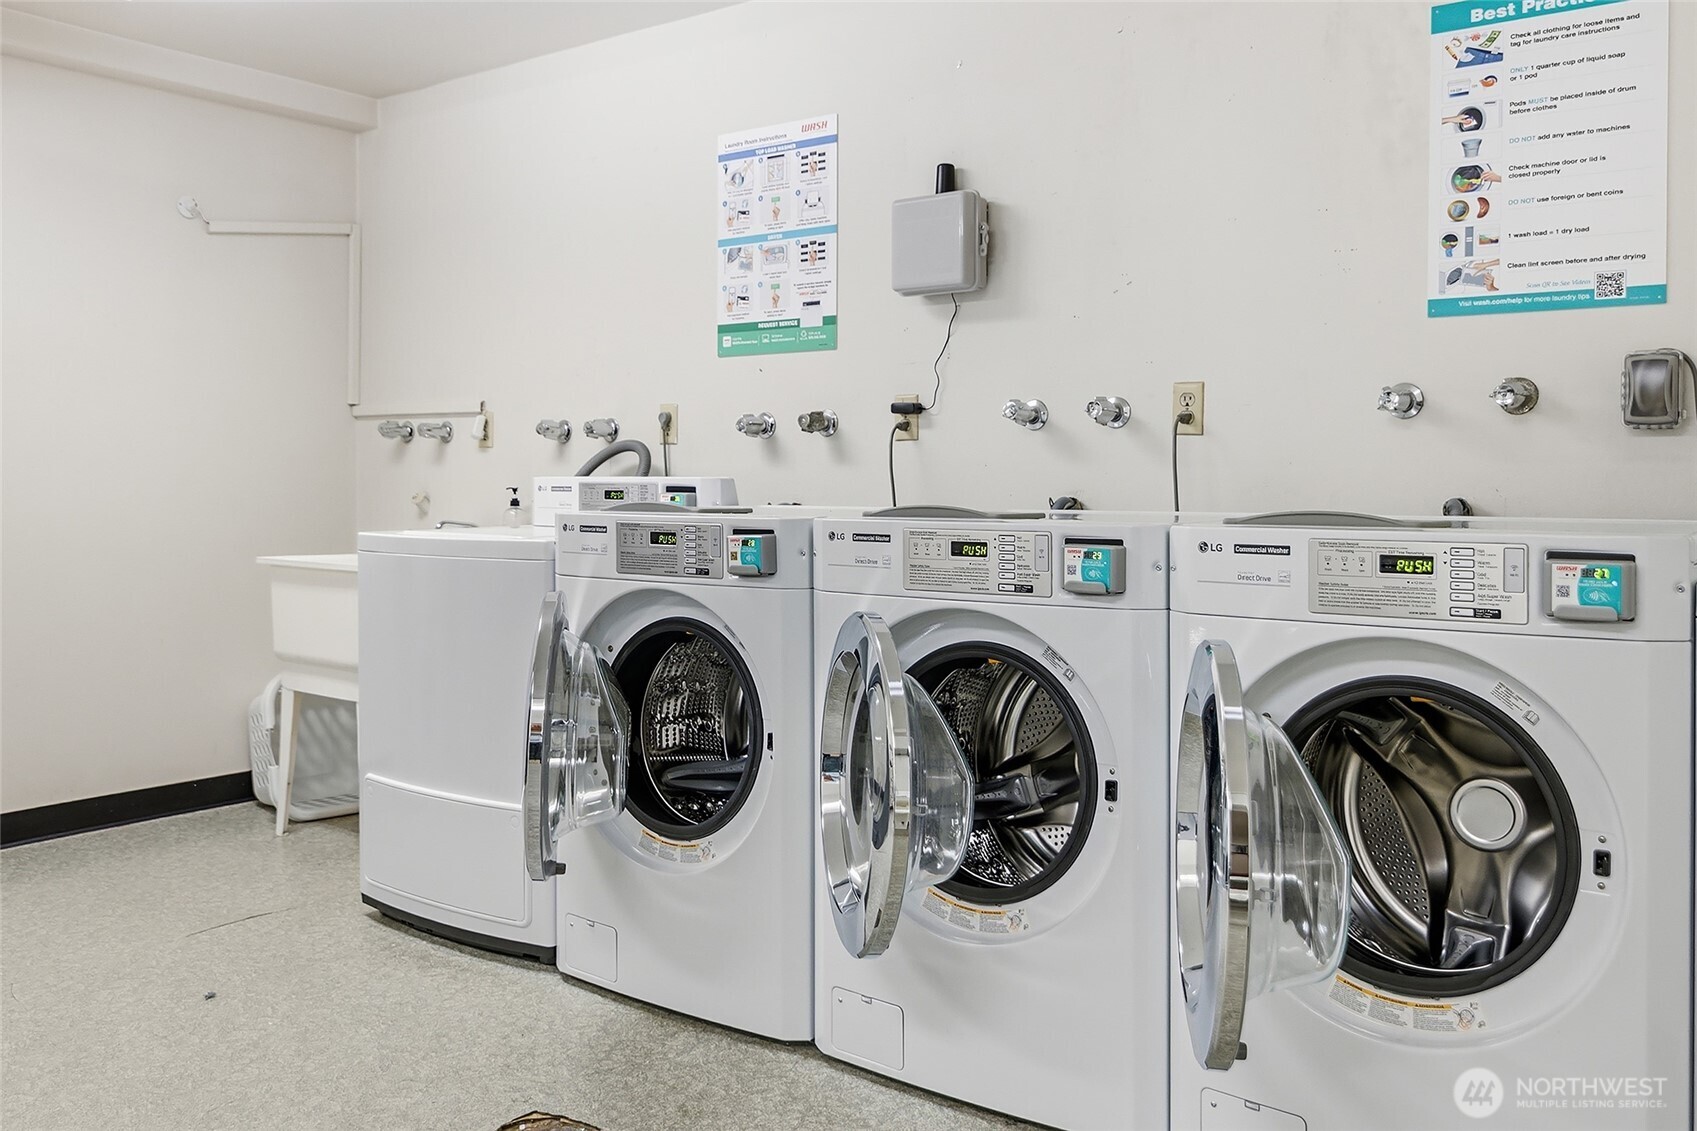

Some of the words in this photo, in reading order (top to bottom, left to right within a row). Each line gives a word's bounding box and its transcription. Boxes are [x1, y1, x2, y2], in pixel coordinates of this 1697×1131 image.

[1471, 3, 1516, 23] Best
[1522, 0, 1596, 14] Prac
[1510, 30, 1532, 40] Check
[1533, 28, 1541, 36] all
[1542, 25, 1571, 35] clothing
[1583, 20, 1604, 28] loose
[1604, 17, 1625, 25] items
[1626, 13, 1640, 21] and
[1510, 39, 1521, 48] tag
[1522, 38, 1532, 46] for
[1533, 34, 1560, 43] laundry
[1561, 31, 1577, 39] care
[1578, 25, 1620, 36] instructions
[1510, 66, 1529, 74] ONLY
[1536, 61, 1561, 71] quarter
[1562, 58, 1576, 67] cup
[1577, 56, 1585, 64] of
[1586, 53, 1606, 62] liquid
[1607, 51, 1626, 60] soap
[1524, 72, 1538, 81] pod
[1509, 100, 1527, 108] Pods
[1528, 96, 1549, 105] MUST
[1560, 91, 1584, 102] placed
[1585, 88, 1607, 97] inside
[1617, 84, 1637, 92] drum
[1509, 107, 1531, 116] before
[1532, 104, 1558, 112] clothes
[801, 121, 828, 133] WASH
[1537, 132, 1551, 141] add
[1552, 131, 1565, 140] any
[1566, 129, 1585, 137] water
[1596, 124, 1631, 133] machines
[724, 142, 744, 150] Laundry
[759, 133, 788, 143] Instructions
[1508, 163, 1530, 172] Check
[1531, 160, 1560, 169] machine
[1561, 158, 1578, 166] door
[1508, 171, 1531, 180] closed
[1532, 167, 1561, 178] properly
[1508, 198, 1519, 206] DO
[1520, 197, 1535, 205] NOT
[1550, 194, 1576, 202] foreign
[1586, 190, 1602, 198] bent
[1603, 188, 1624, 196] coins
[1513, 230, 1531, 238] wash
[1532, 228, 1548, 236] load
[1561, 226, 1573, 236] dry
[1574, 224, 1590, 233] load
[1507, 261, 1527, 269] Clean
[1528, 259, 1539, 267] lint
[1540, 258, 1564, 266] screen
[1565, 255, 1588, 264] before
[1589, 253, 1603, 261] and
[1604, 251, 1621, 260] after
[1622, 252, 1646, 260] drying
[1526, 281, 1541, 289] Scan
[1541, 281, 1551, 290] QR
[1559, 279, 1571, 287] See
[1572, 278, 1591, 286] Videos
[1458, 299, 1473, 307] Visit
[1473, 297, 1523, 307] wash.com/help
[1523, 295, 1533, 303] for
[1534, 294, 1551, 302] more
[1552, 292, 1577, 302] laundry
[1577, 293, 1591, 301] tips
[568, 524, 575, 532] LG
[658, 534, 677, 544] PUSH
[836, 532, 846, 541] LG
[962, 545, 988, 556] PUSH
[1210, 543, 1223, 553] LG
[1235, 545, 1267, 553] Commercial
[1267, 547, 1290, 555] Washer
[1396, 559, 1433, 573] PUSH
[1237, 573, 1255, 582] Direct
